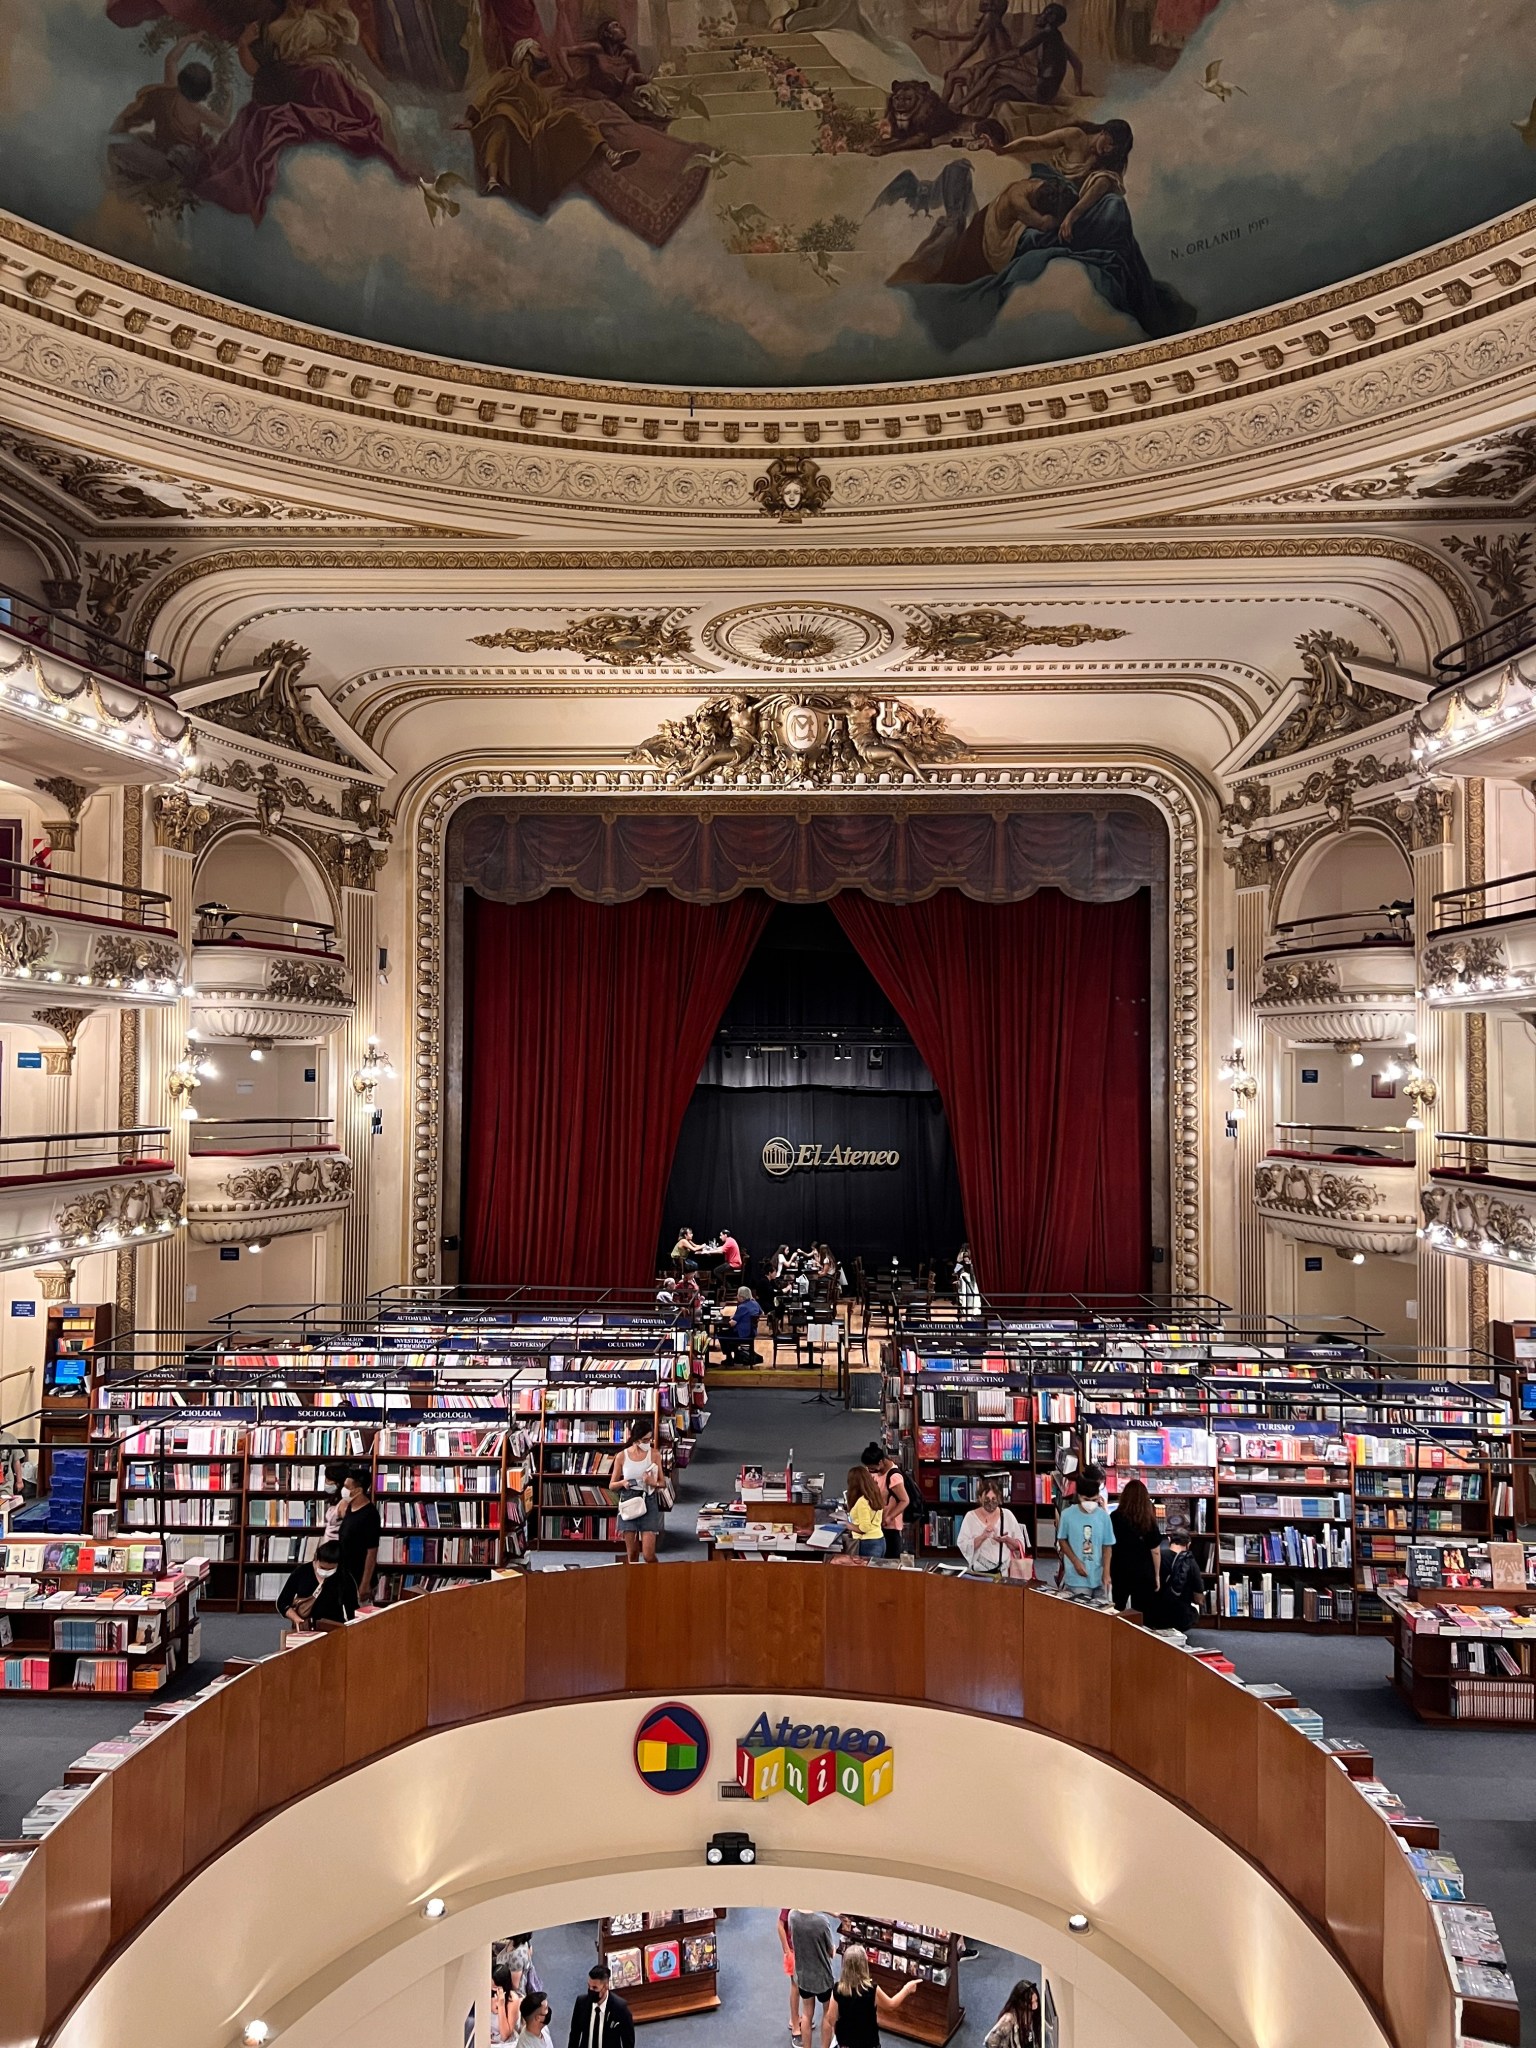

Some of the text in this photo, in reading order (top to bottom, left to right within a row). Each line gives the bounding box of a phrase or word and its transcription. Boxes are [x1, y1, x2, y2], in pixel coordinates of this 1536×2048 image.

[1186, 228, 1241, 254] ORLANDI
[794, 1143, 900, 1166] El Ateneo
[297, 1410, 347, 1418] SOCIOLOGIA
[422, 1411, 473, 1419] SOCIOLOGIA
[1125, 1419, 1163, 1428] TURISMO
[1256, 1422, 1296, 1431] TURISMO
[743, 1711, 886, 1755] Ateneo
[738, 1751, 892, 1796] Junior
